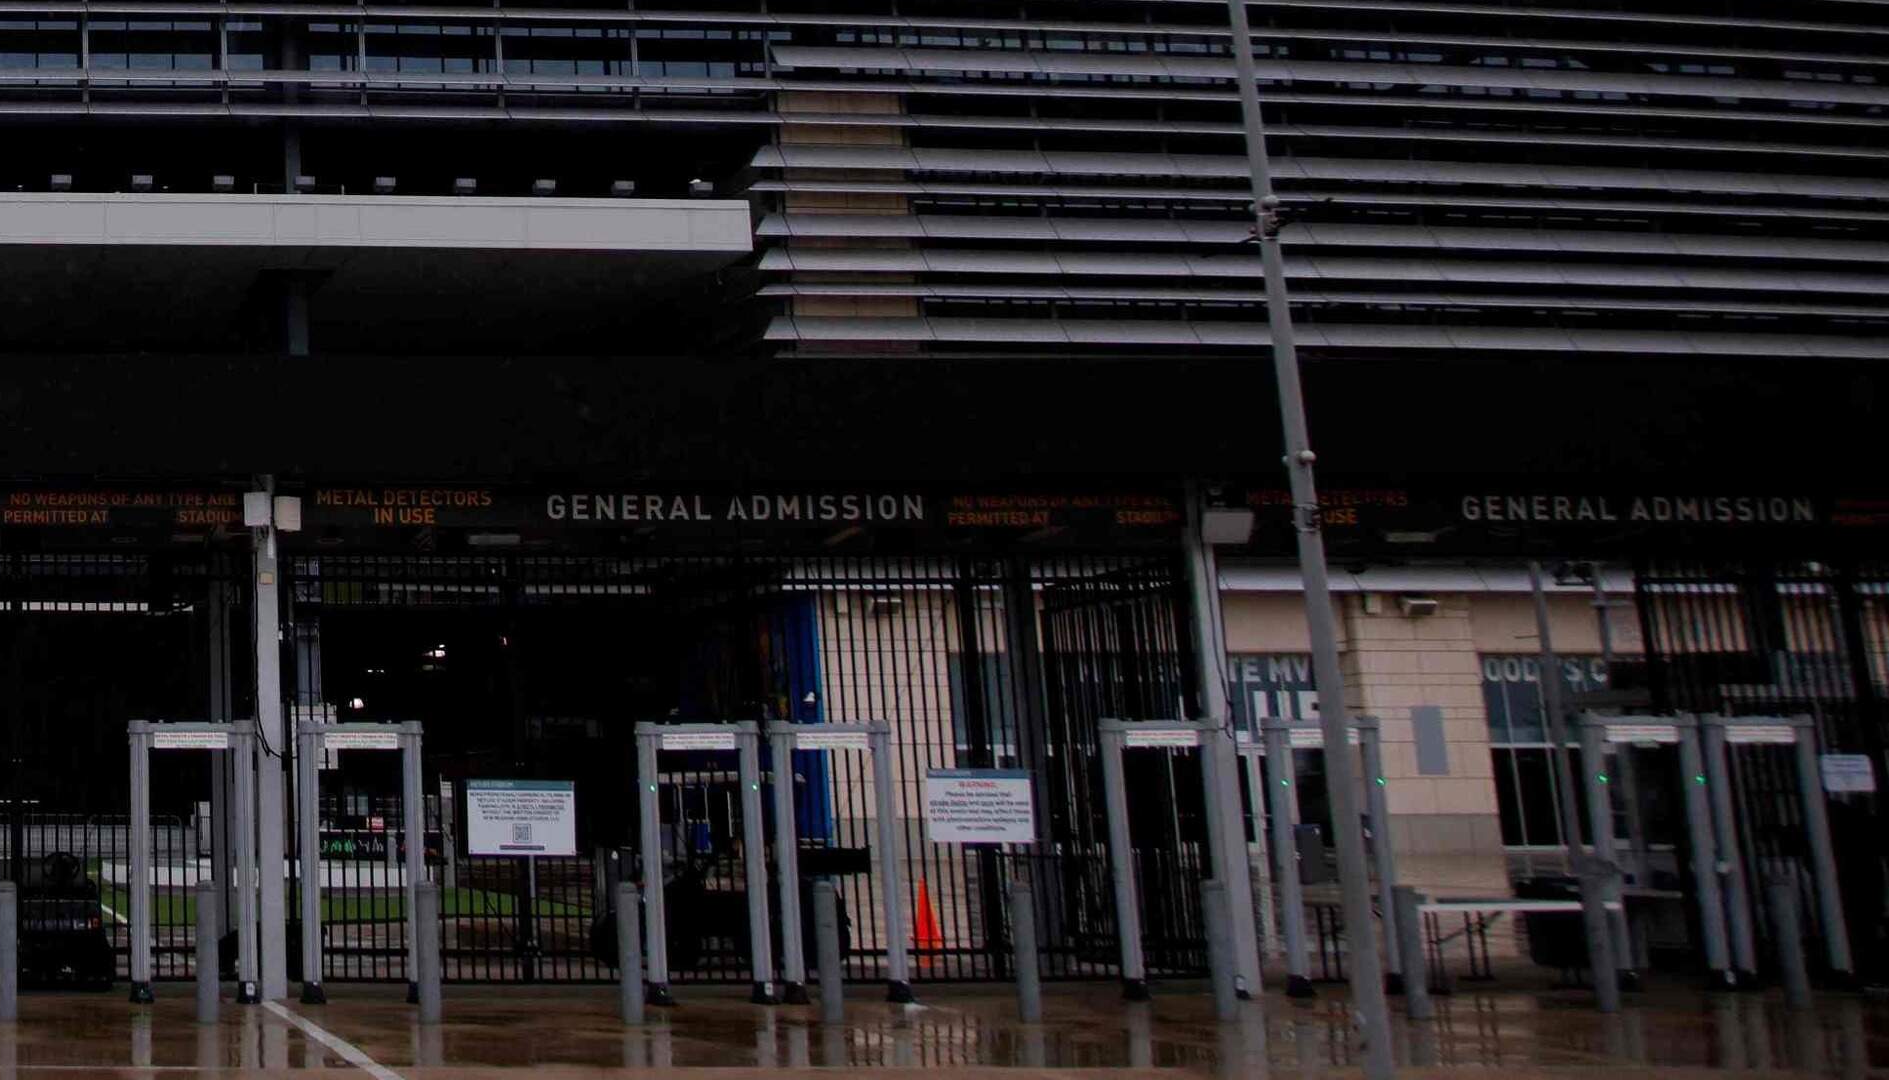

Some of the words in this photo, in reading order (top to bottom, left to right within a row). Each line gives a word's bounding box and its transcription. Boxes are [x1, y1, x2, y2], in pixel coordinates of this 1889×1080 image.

[10, 492, 31, 506] NO
[35, 492, 107, 506] WEAPONS
[315, 489, 378, 506] METAL
[383, 489, 493, 507] DETECTORS
[374, 507, 394, 524] IN
[398, 507, 436, 524] USE
[545, 494, 713, 520] GENERAL
[726, 494, 923, 521] ADMISSION
[1461, 495, 1615, 521] GENERAL
[1631, 495, 1814, 522] ADMISSION
[4, 510, 87, 524] PERMITTED
[90, 510, 109, 524] AT
